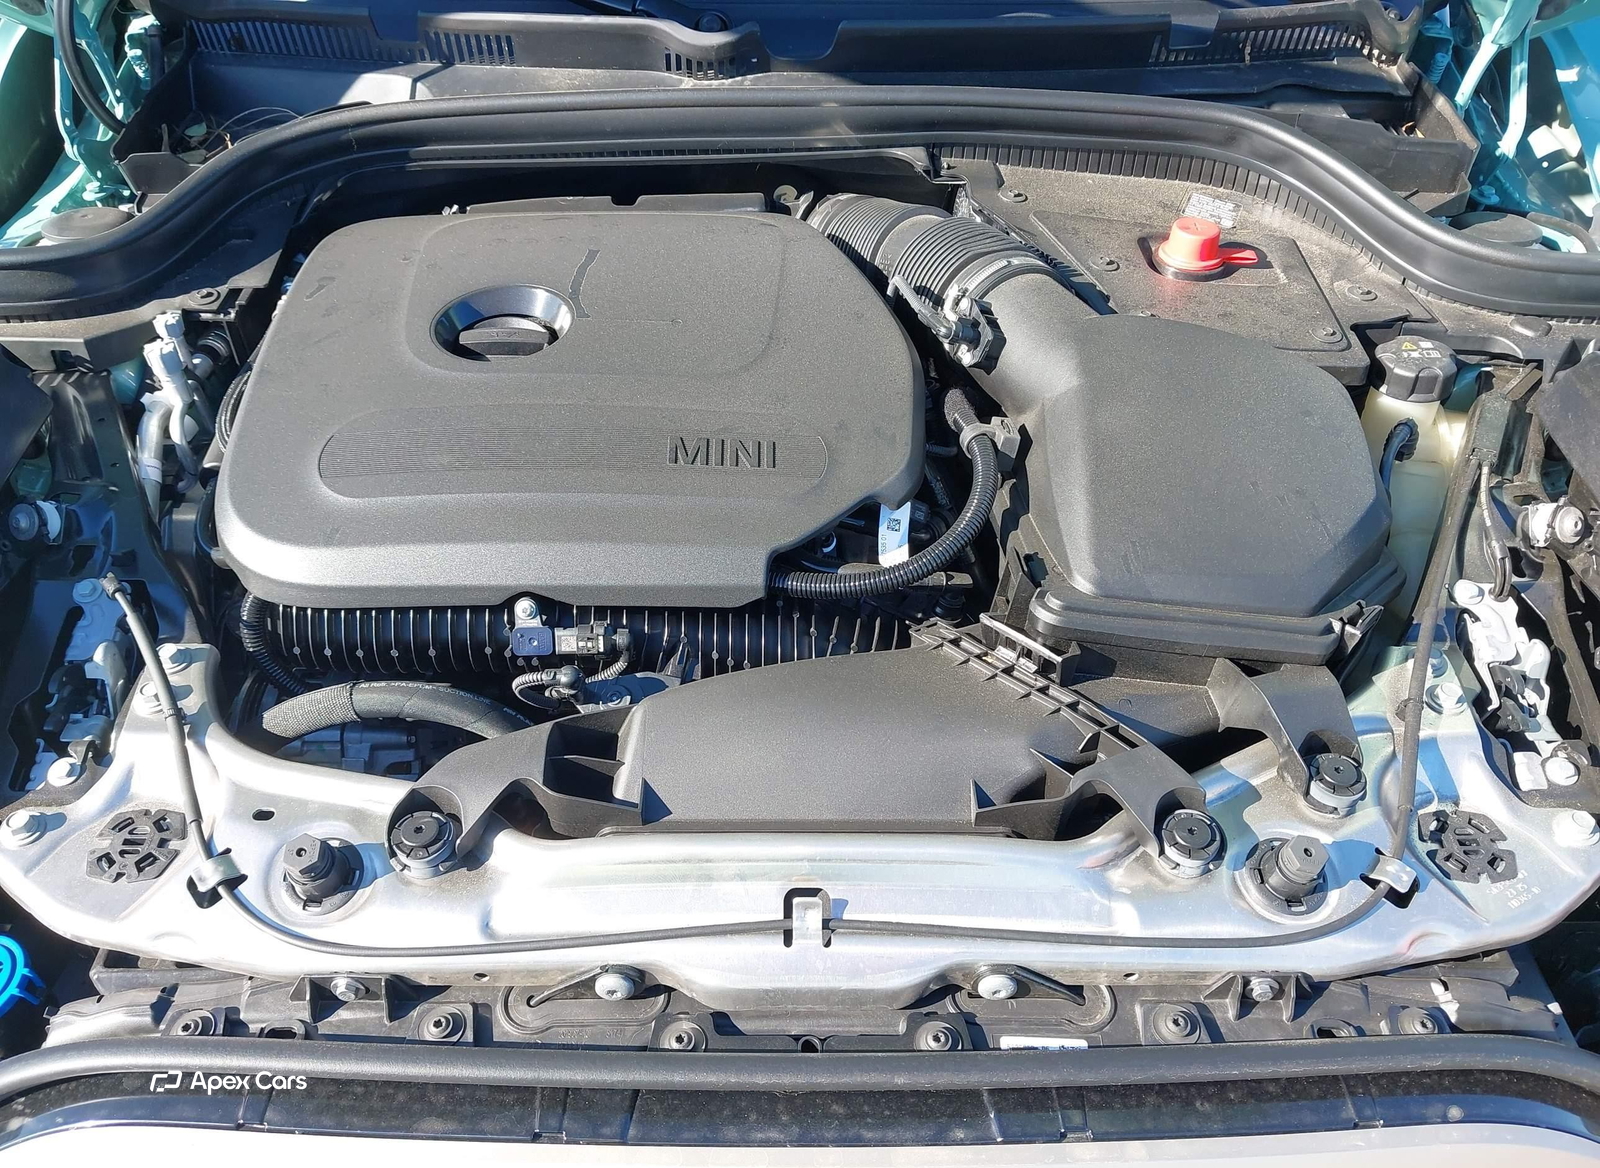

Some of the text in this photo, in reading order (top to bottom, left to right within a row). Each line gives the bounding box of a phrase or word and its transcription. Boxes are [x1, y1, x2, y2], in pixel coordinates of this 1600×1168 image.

[667, 435, 776, 469] MINI
[438, 686, 474, 699] SUCTION
[474, 694, 491, 705] LINE
